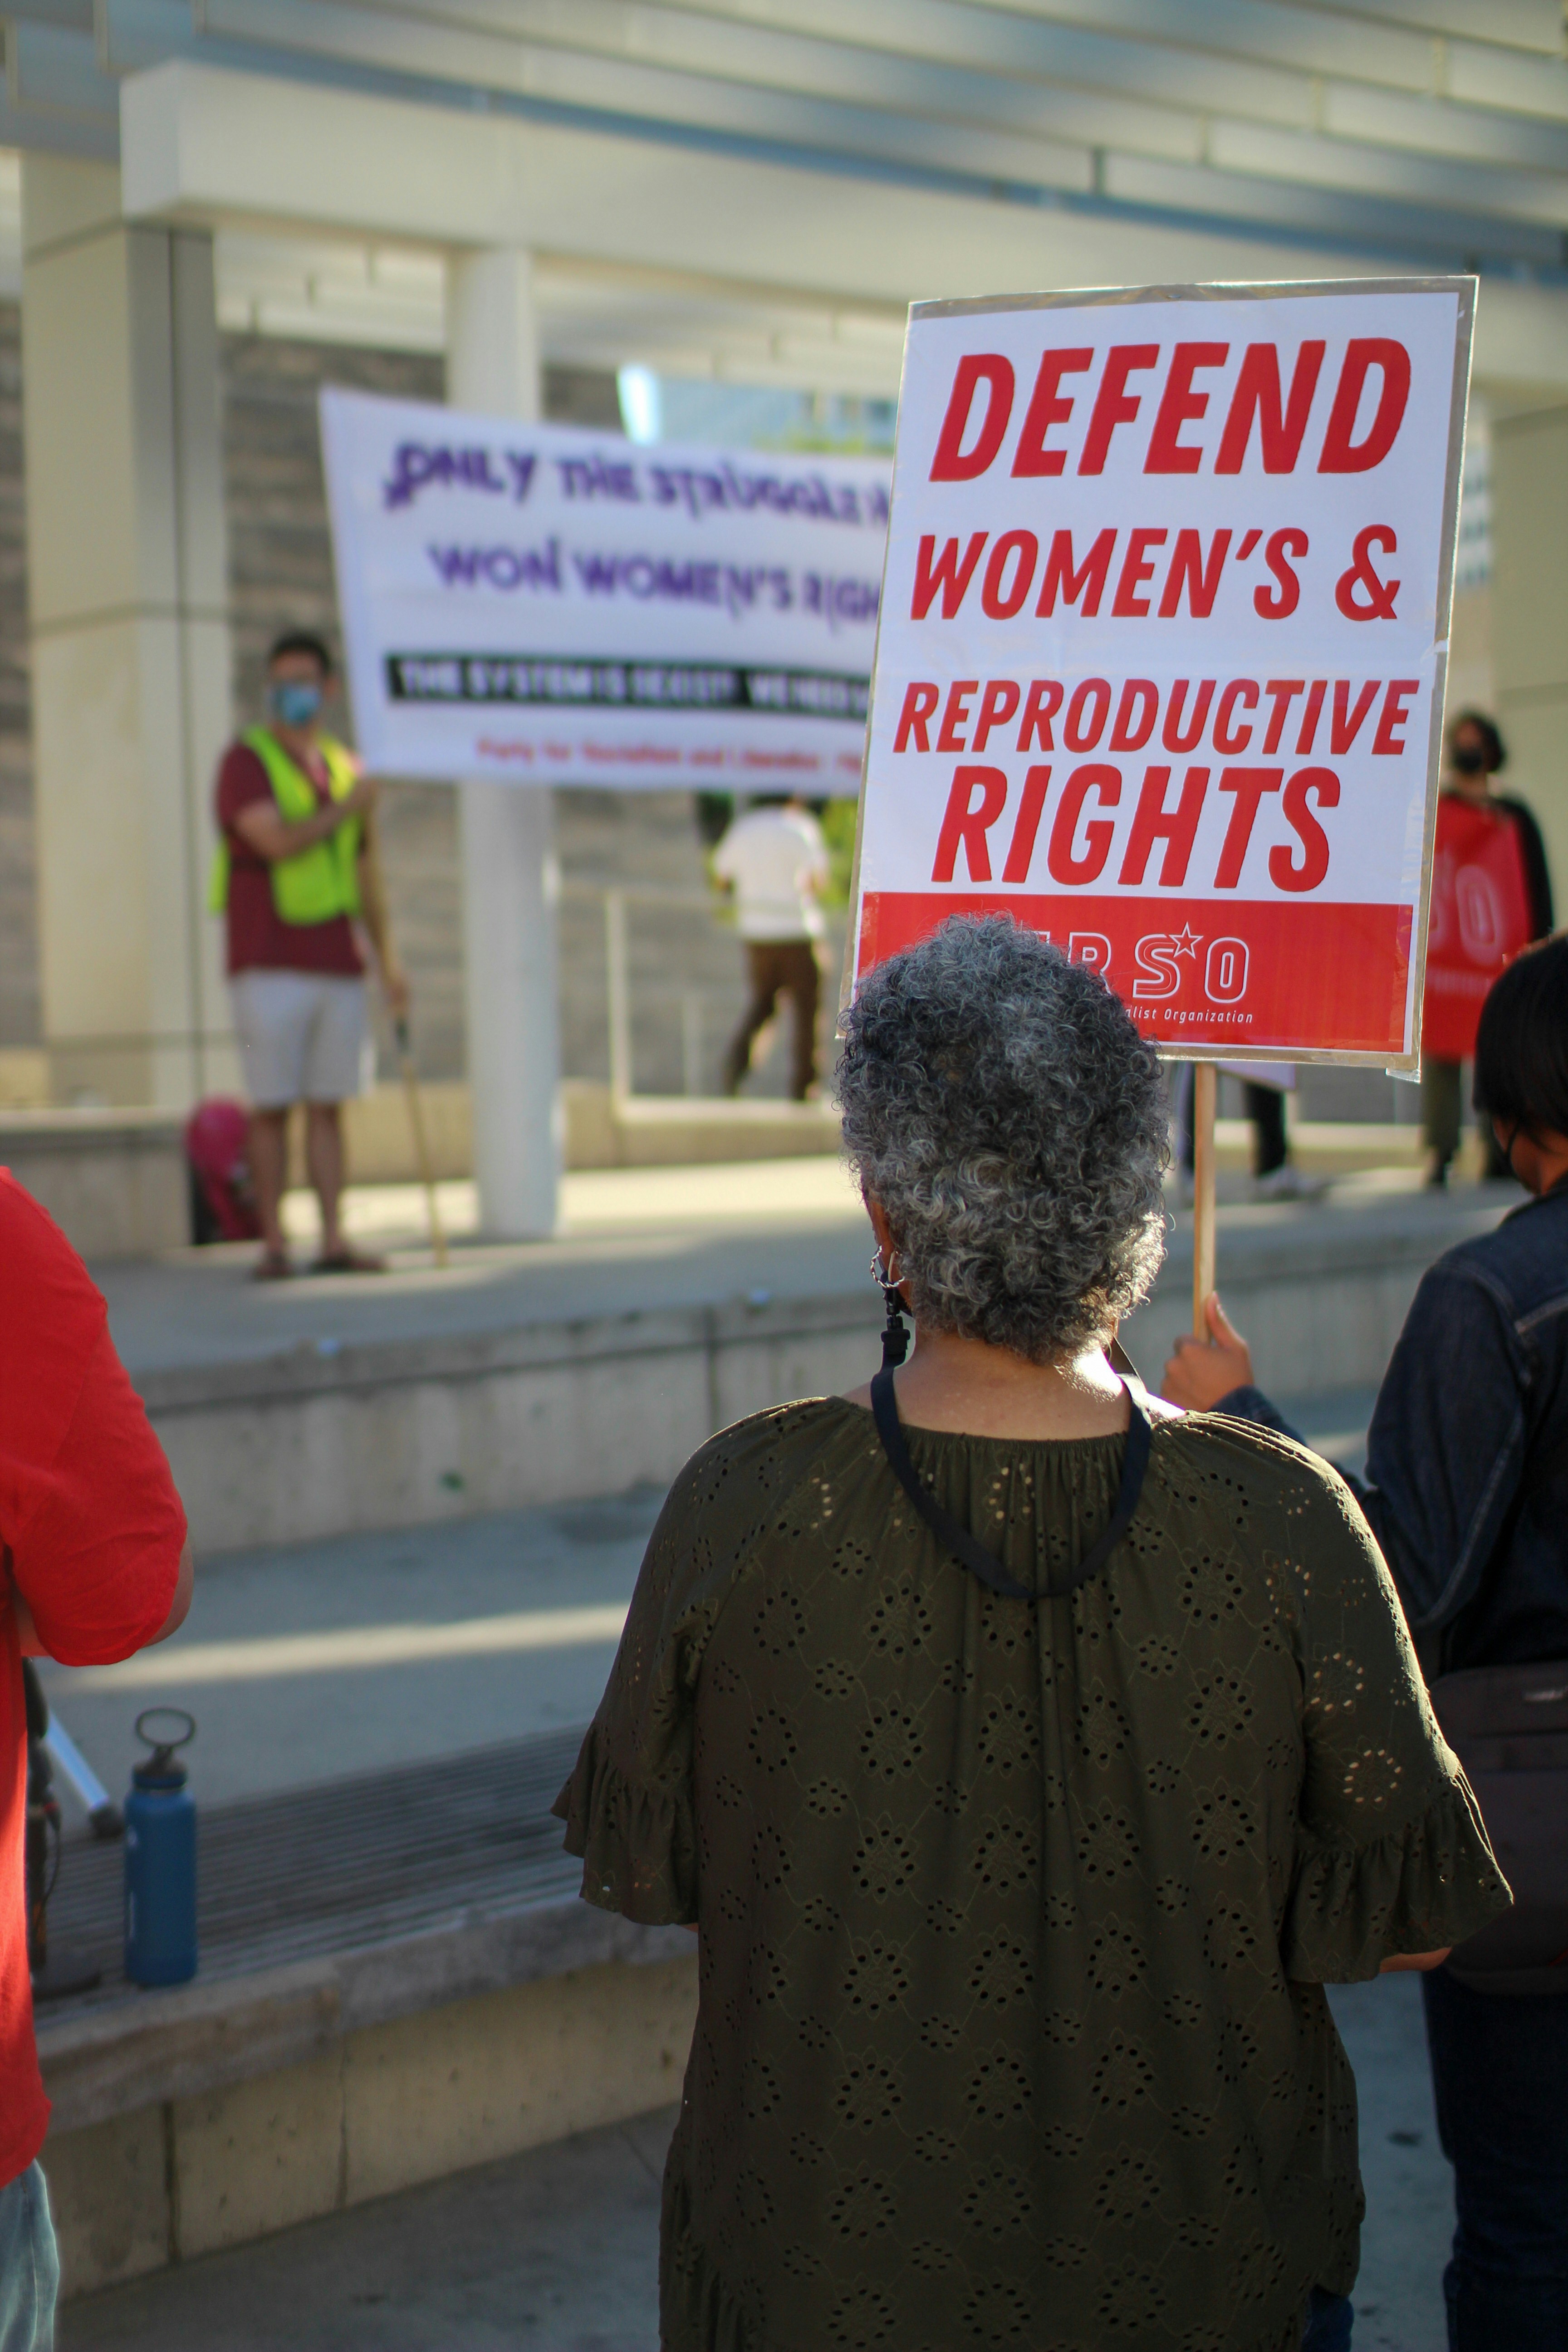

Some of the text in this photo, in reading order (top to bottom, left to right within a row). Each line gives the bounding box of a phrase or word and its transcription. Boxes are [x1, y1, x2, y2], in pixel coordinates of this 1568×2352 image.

[929, 338, 1411, 482] DEFEND
[382, 438, 537, 511] ONLY
[555, 454, 640, 503] THE
[650, 463, 862, 525] STRUGGLE
[427, 538, 879, 632] WON WOMEN'S RIGH
[910, 524, 1400, 621] WOMEN'S &
[893, 678, 1419, 755] REPRODUCTIVE
[931, 764, 1340, 892] RIGHTS
[1014, 930, 1250, 1004] RSO
[1163, 1008, 1253, 1024] Organization
